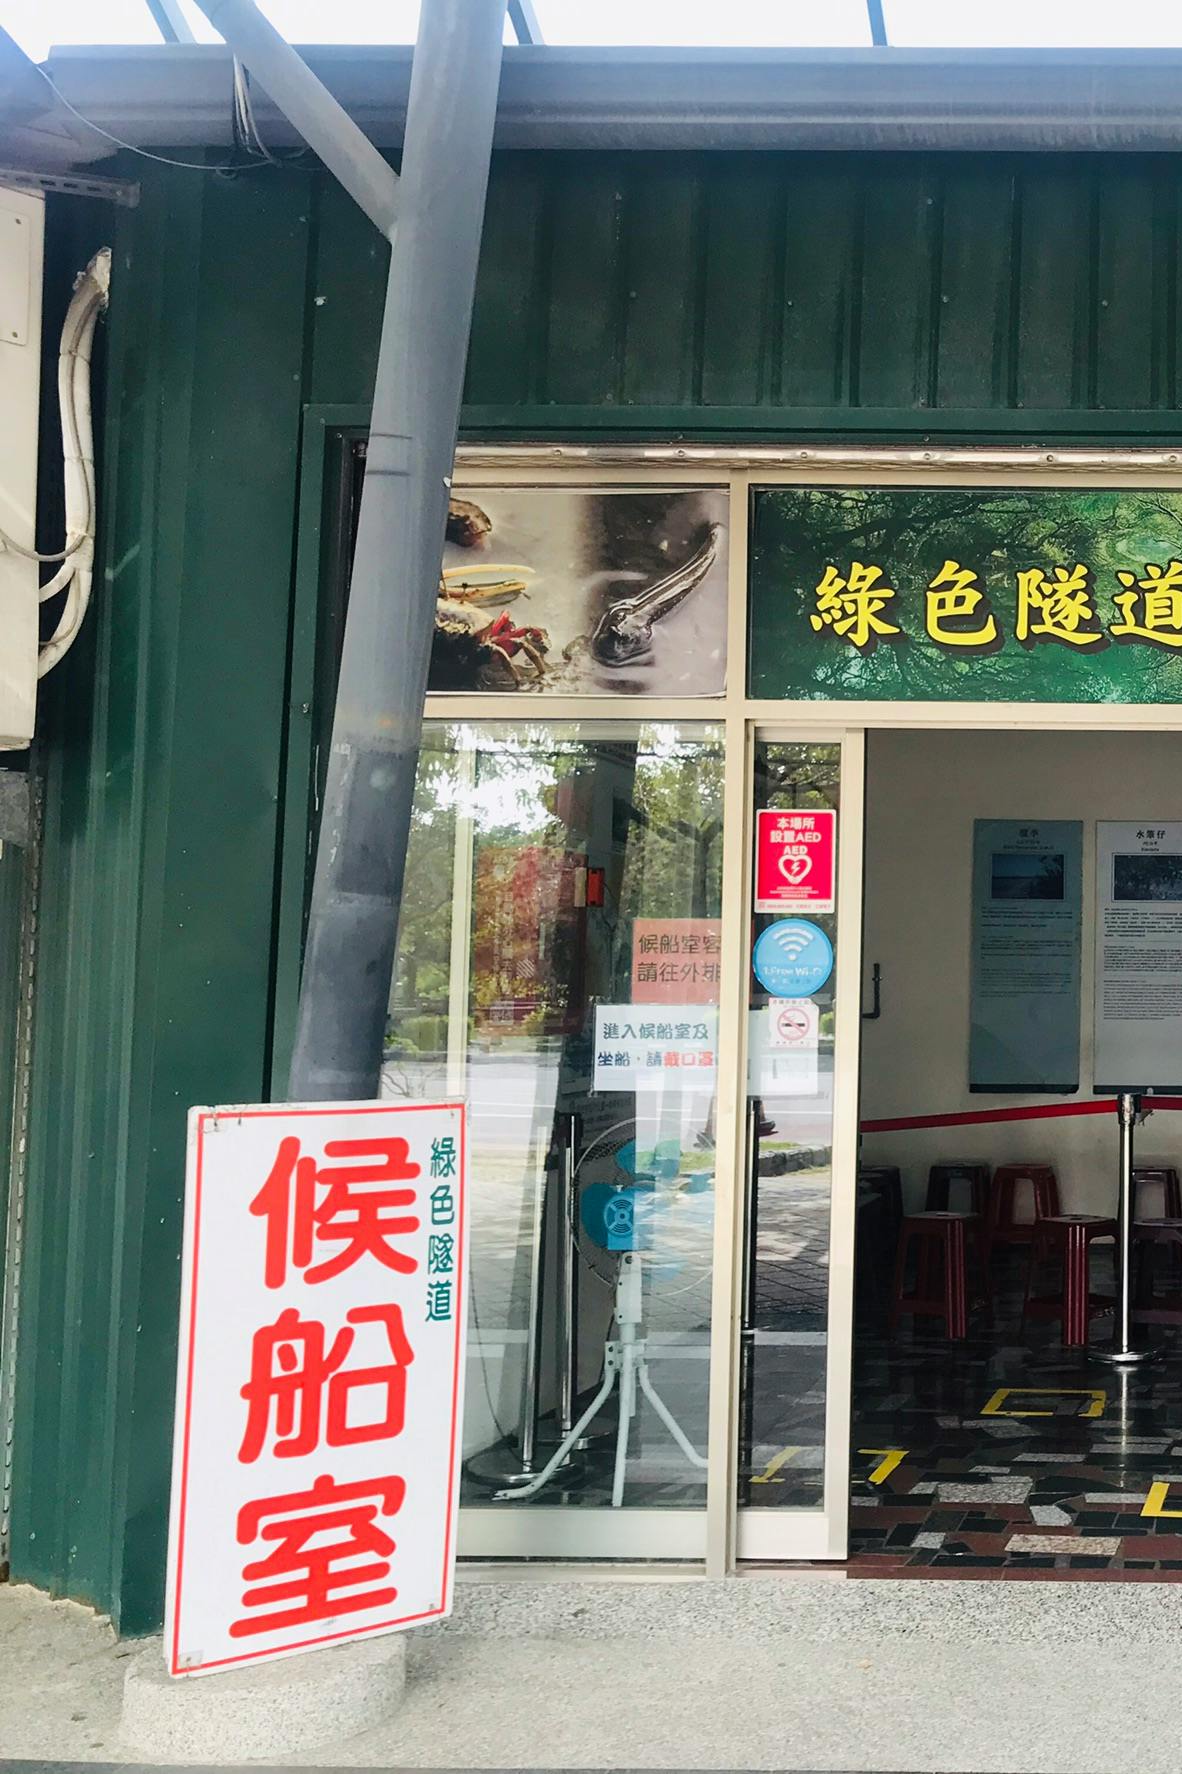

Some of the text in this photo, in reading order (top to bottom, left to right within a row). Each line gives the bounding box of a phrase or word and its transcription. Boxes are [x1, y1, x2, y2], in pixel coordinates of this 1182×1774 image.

[777, 817, 815, 830] 本場所
[770, 832, 822, 844] 設置AED
[784, 845, 808, 855] AED
[603, 1023, 709, 1040] 進入候船室及
[425, 1136, 457, 1323] 綠色隧道
[229, 1135, 421, 1638] 候船室
